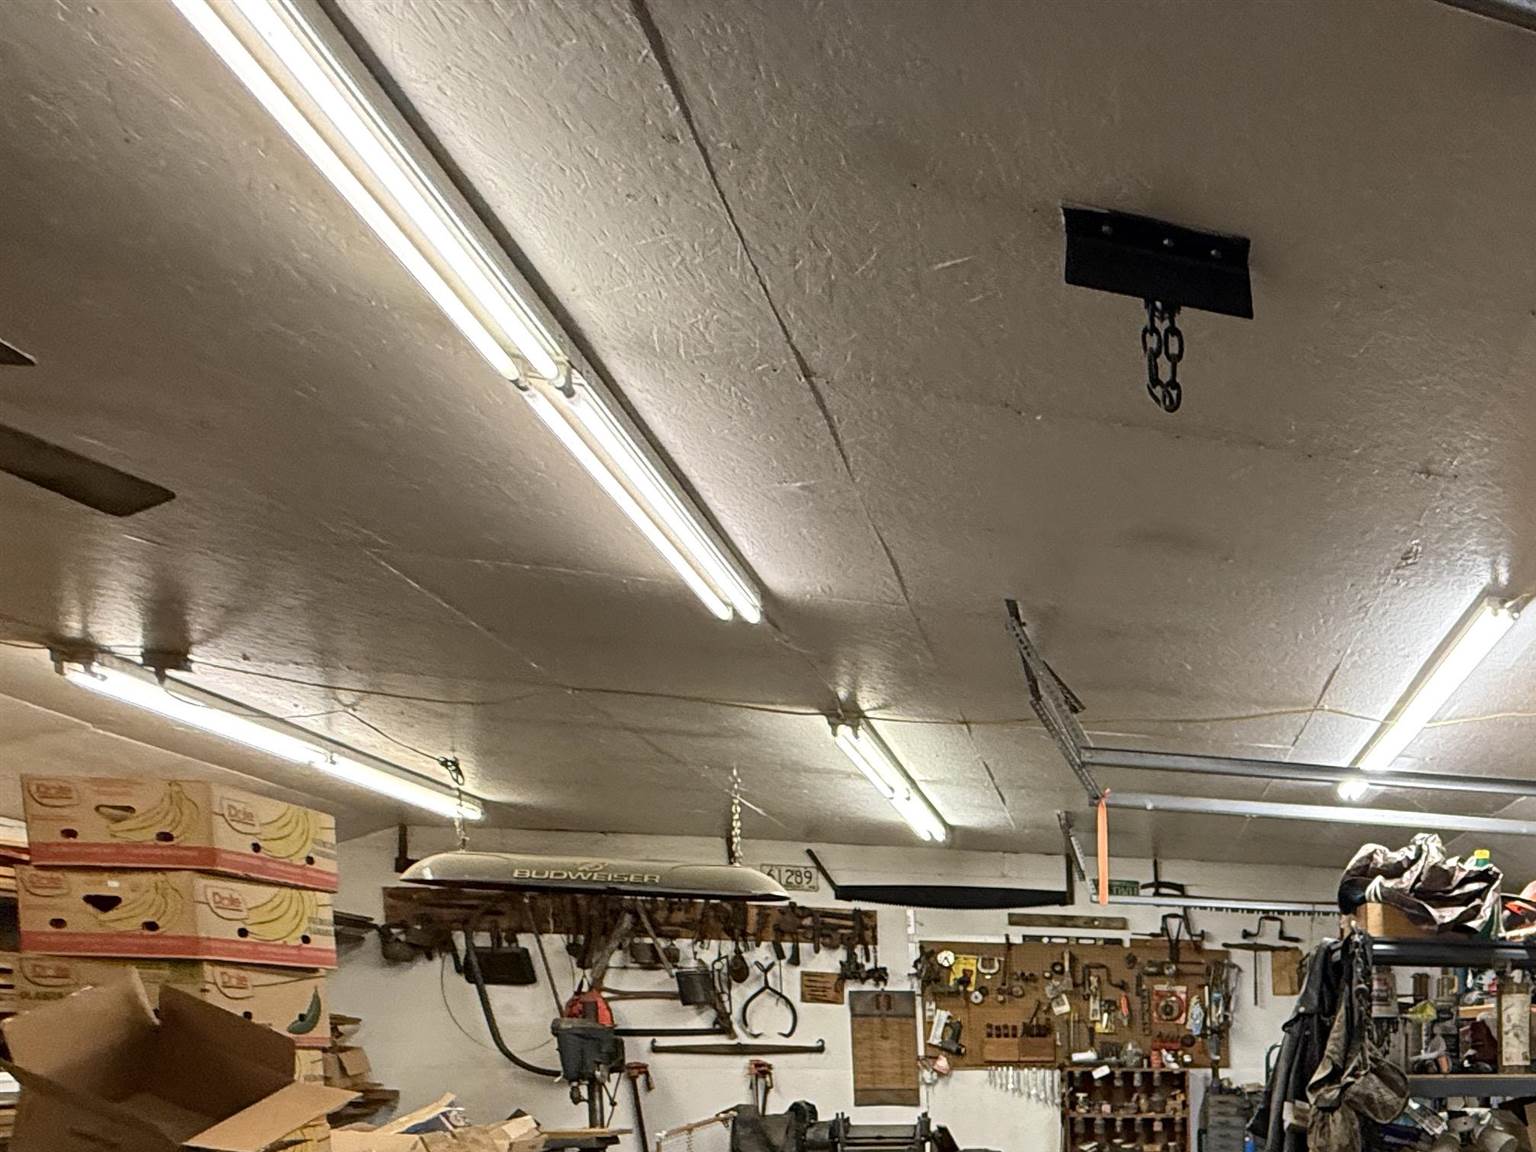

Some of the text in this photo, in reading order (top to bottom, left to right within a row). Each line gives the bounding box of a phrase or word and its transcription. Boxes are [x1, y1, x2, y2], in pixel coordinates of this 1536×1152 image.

[227, 804, 255, 822] Dole
[513, 868, 660, 883] BUDWEISER
[212, 892, 241, 908] Dole
